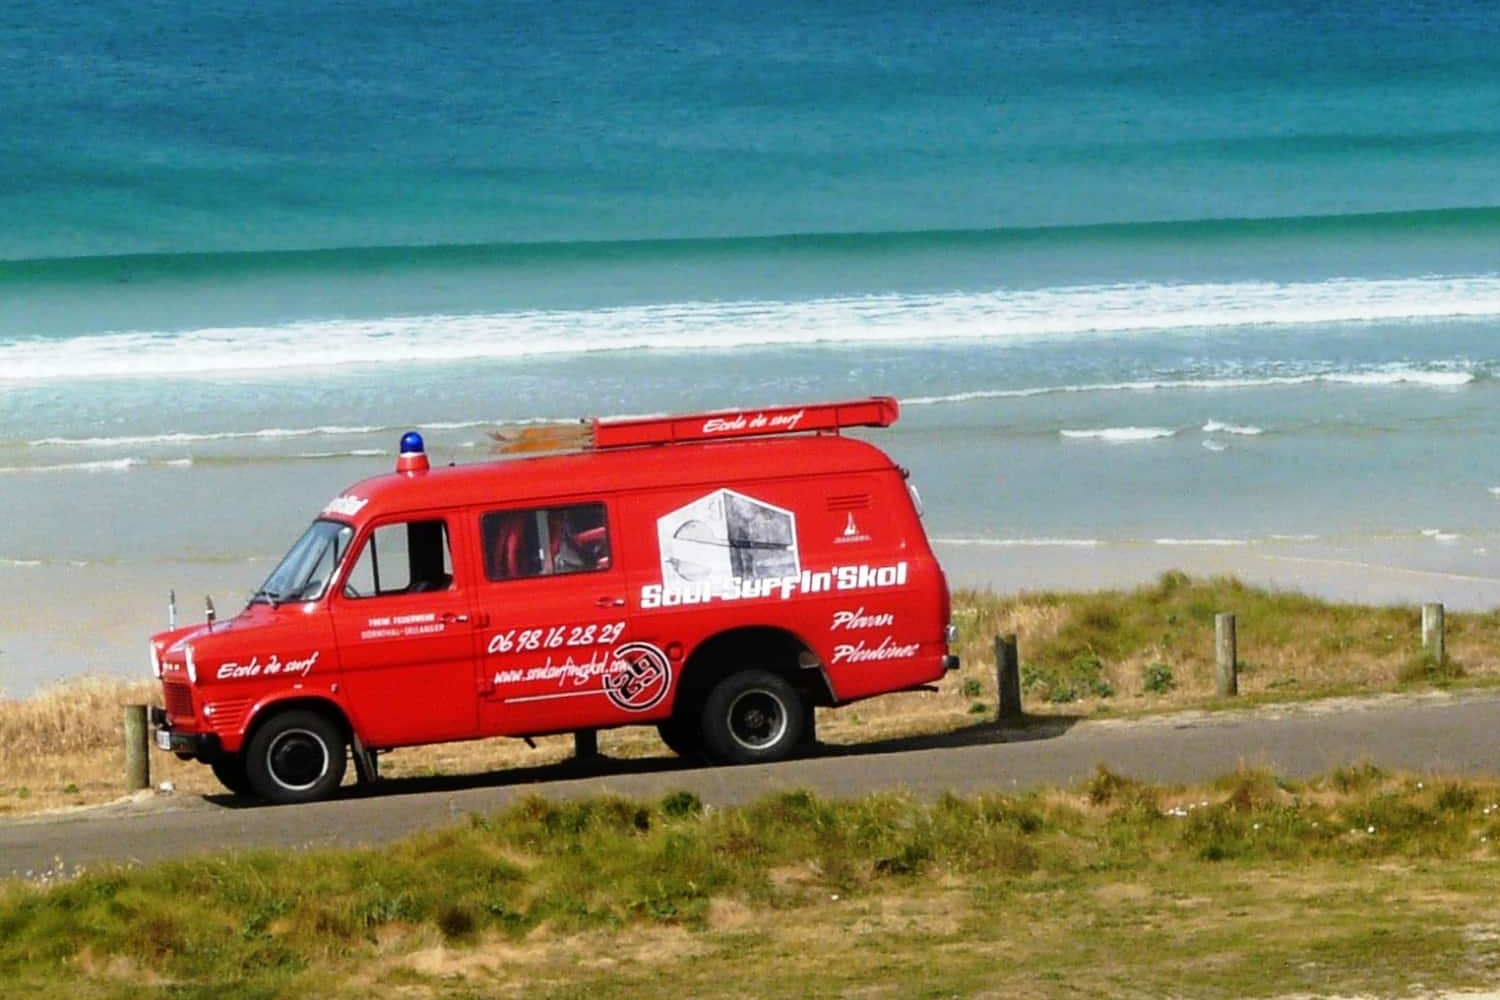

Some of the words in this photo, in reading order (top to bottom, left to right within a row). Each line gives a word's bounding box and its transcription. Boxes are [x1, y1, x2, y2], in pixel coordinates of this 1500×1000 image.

[702, 414, 747, 433] Ecole
[748, 413, 769, 428] de
[768, 409, 805, 431] surf
[487, 630, 516, 653] 06
[515, 629, 544, 652] 98
[543, 626, 567, 648] 16
[566, 625, 598, 647] 28
[597, 621, 627, 645] 29
[216, 656, 262, 680] Ecole
[263, 655, 282, 675] de
[282, 651, 320, 677] surf
